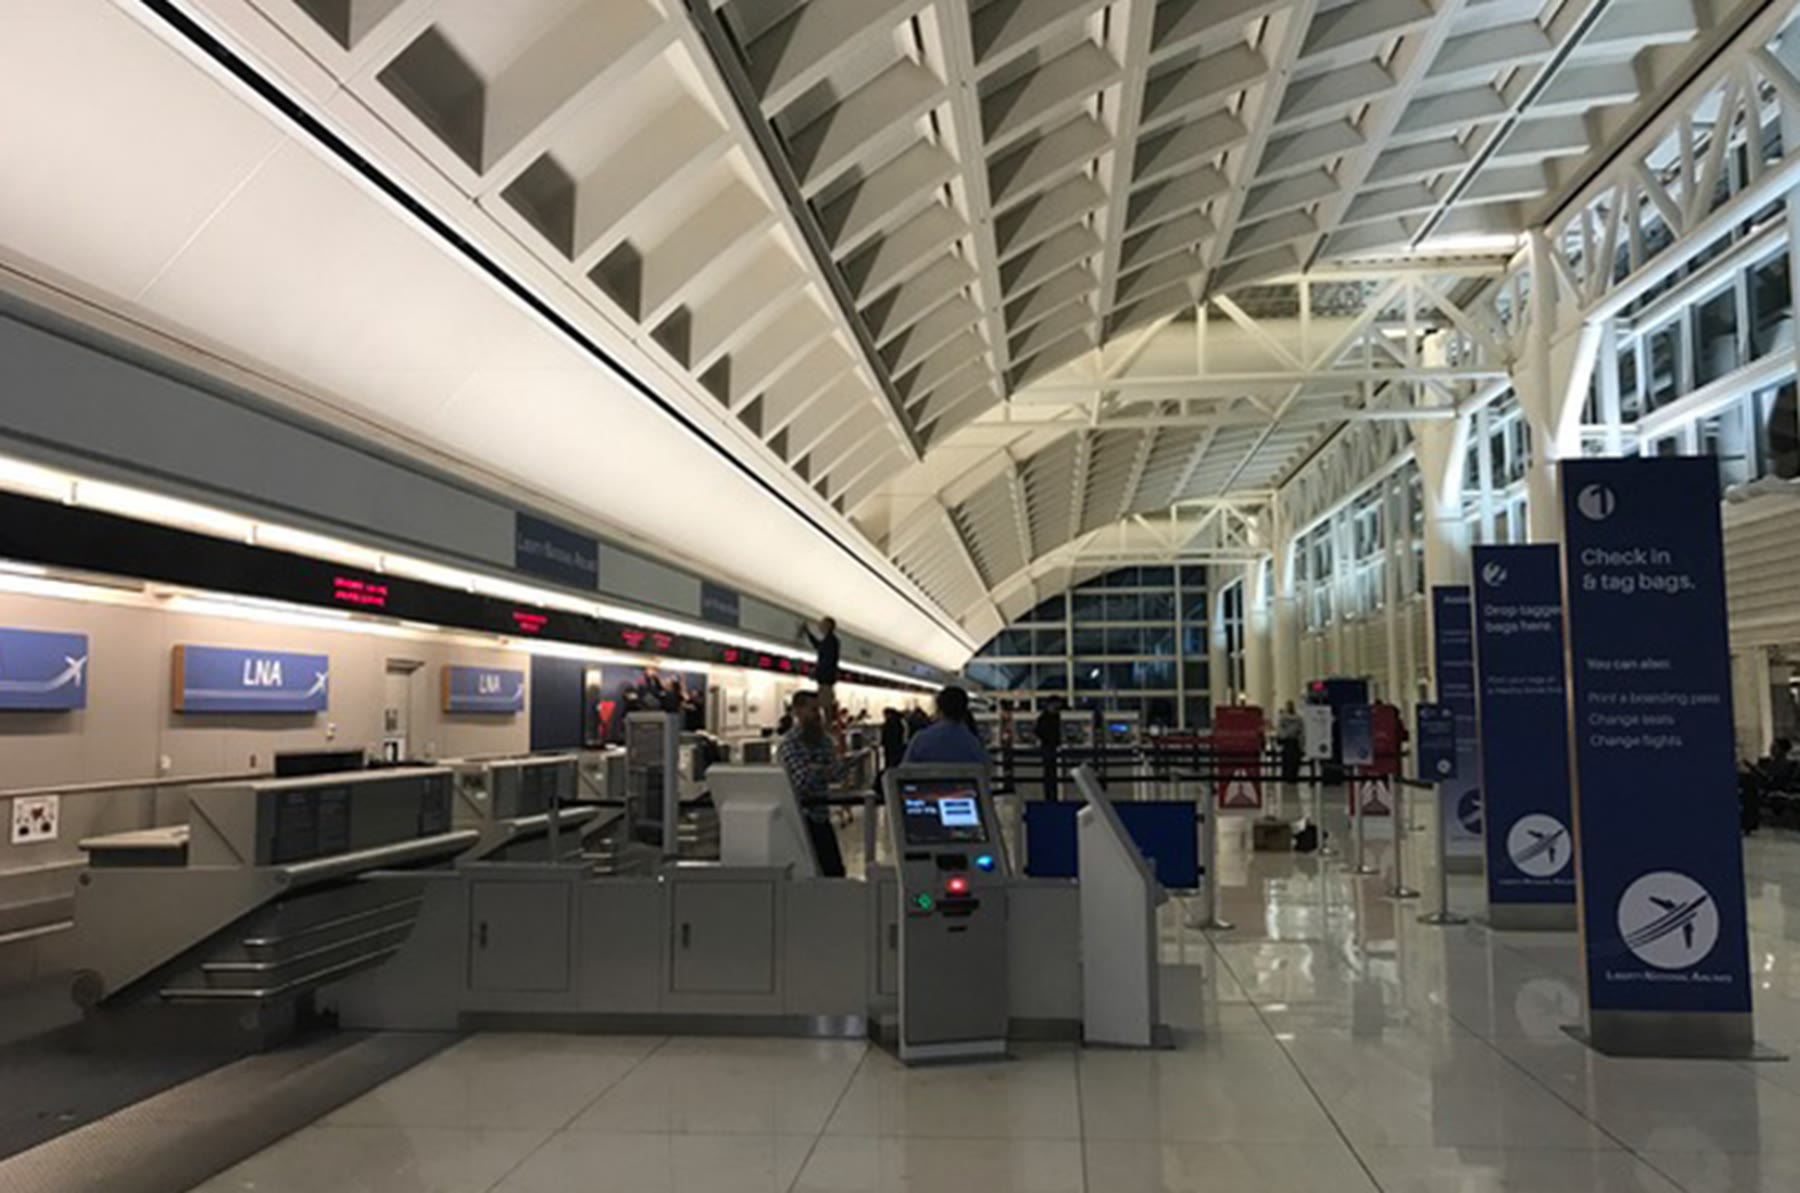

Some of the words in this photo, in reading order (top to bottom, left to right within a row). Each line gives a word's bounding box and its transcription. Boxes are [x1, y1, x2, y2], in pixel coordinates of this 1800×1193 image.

[1581, 548, 1647, 566] Check
[1583, 573, 1597, 590] &
[1600, 574, 1635, 595] tag
[1638, 573, 1696, 594] bags.
[1484, 604, 1517, 618] Drop
[1519, 605, 1562, 618] tagge
[1485, 621, 1518, 635] bags
[1586, 657, 1611, 670] You
[1613, 659, 1637, 670] can
[243, 658, 282, 687] LNA
[479, 673, 501, 694] LNA
[1587, 691, 1617, 703] Print
[1619, 693, 1627, 703] a
[1630, 691, 1688, 706] boarding
[1691, 693, 1721, 705] pass
[1588, 712, 1640, 728] Change
[1642, 713, 1676, 726] seats
[1589, 733, 1640, 749] Change
[1642, 734, 1683, 749] flights
